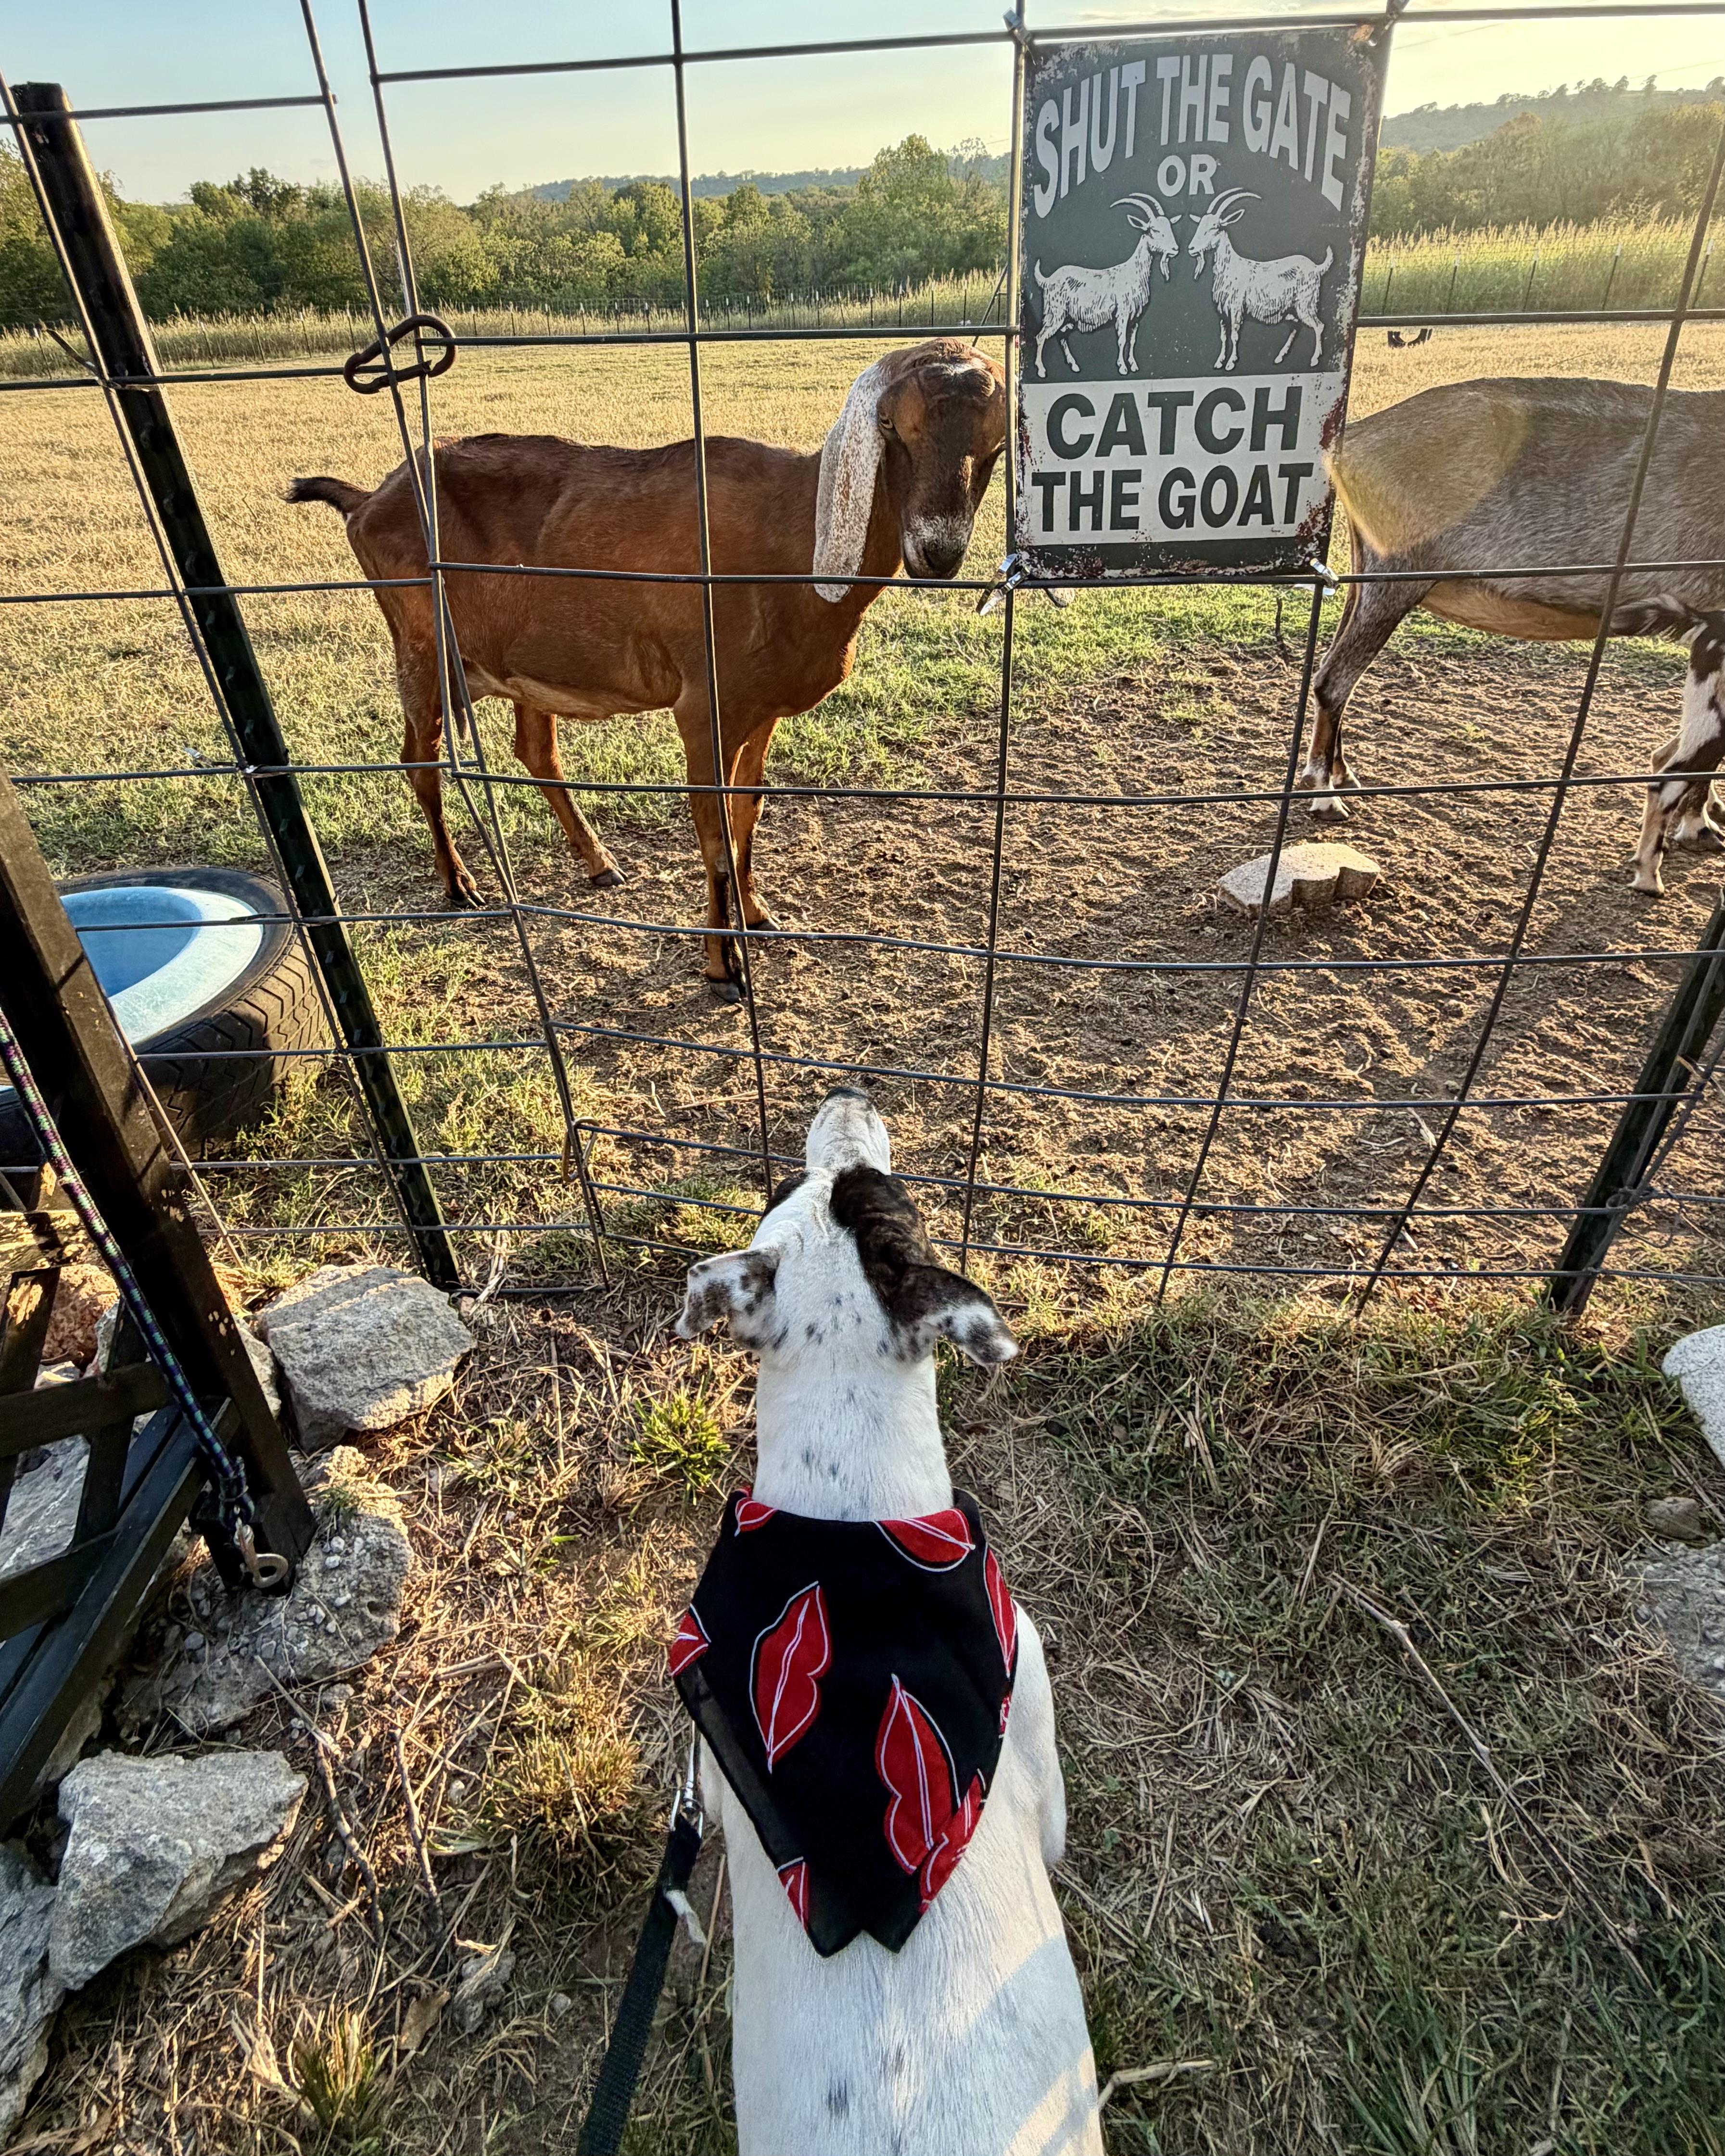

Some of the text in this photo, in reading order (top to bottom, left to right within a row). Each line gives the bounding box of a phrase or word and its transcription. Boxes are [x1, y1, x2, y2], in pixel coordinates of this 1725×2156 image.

[1034, 54, 1351, 218] SHUT THE GATE
[1157, 154, 1217, 197] OR
[1046, 386, 1303, 460] CATCH
[1031, 462, 1314, 532] THE GOAT
